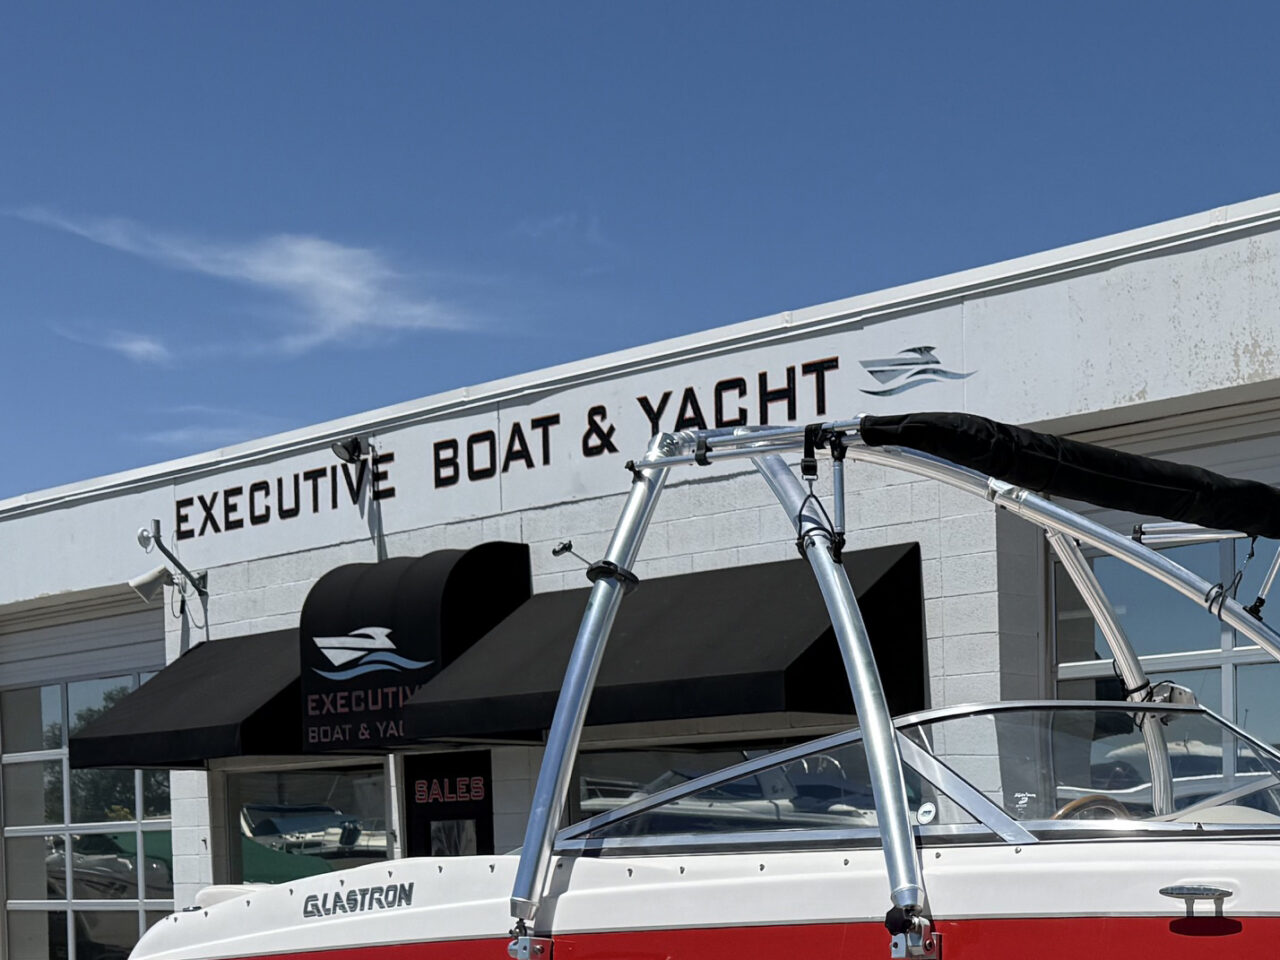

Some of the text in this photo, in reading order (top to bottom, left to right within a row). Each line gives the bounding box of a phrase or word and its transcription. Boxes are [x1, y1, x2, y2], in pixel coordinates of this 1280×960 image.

[175, 355, 840, 541] EXECUTIVE BOAT & YACHT
[307, 684, 422, 716] EXECUTIV
[308, 724, 352, 743] BOAT
[358, 722, 371, 740] &
[414, 776, 485, 804] SALES
[303, 882, 414, 918] GLASTRON
